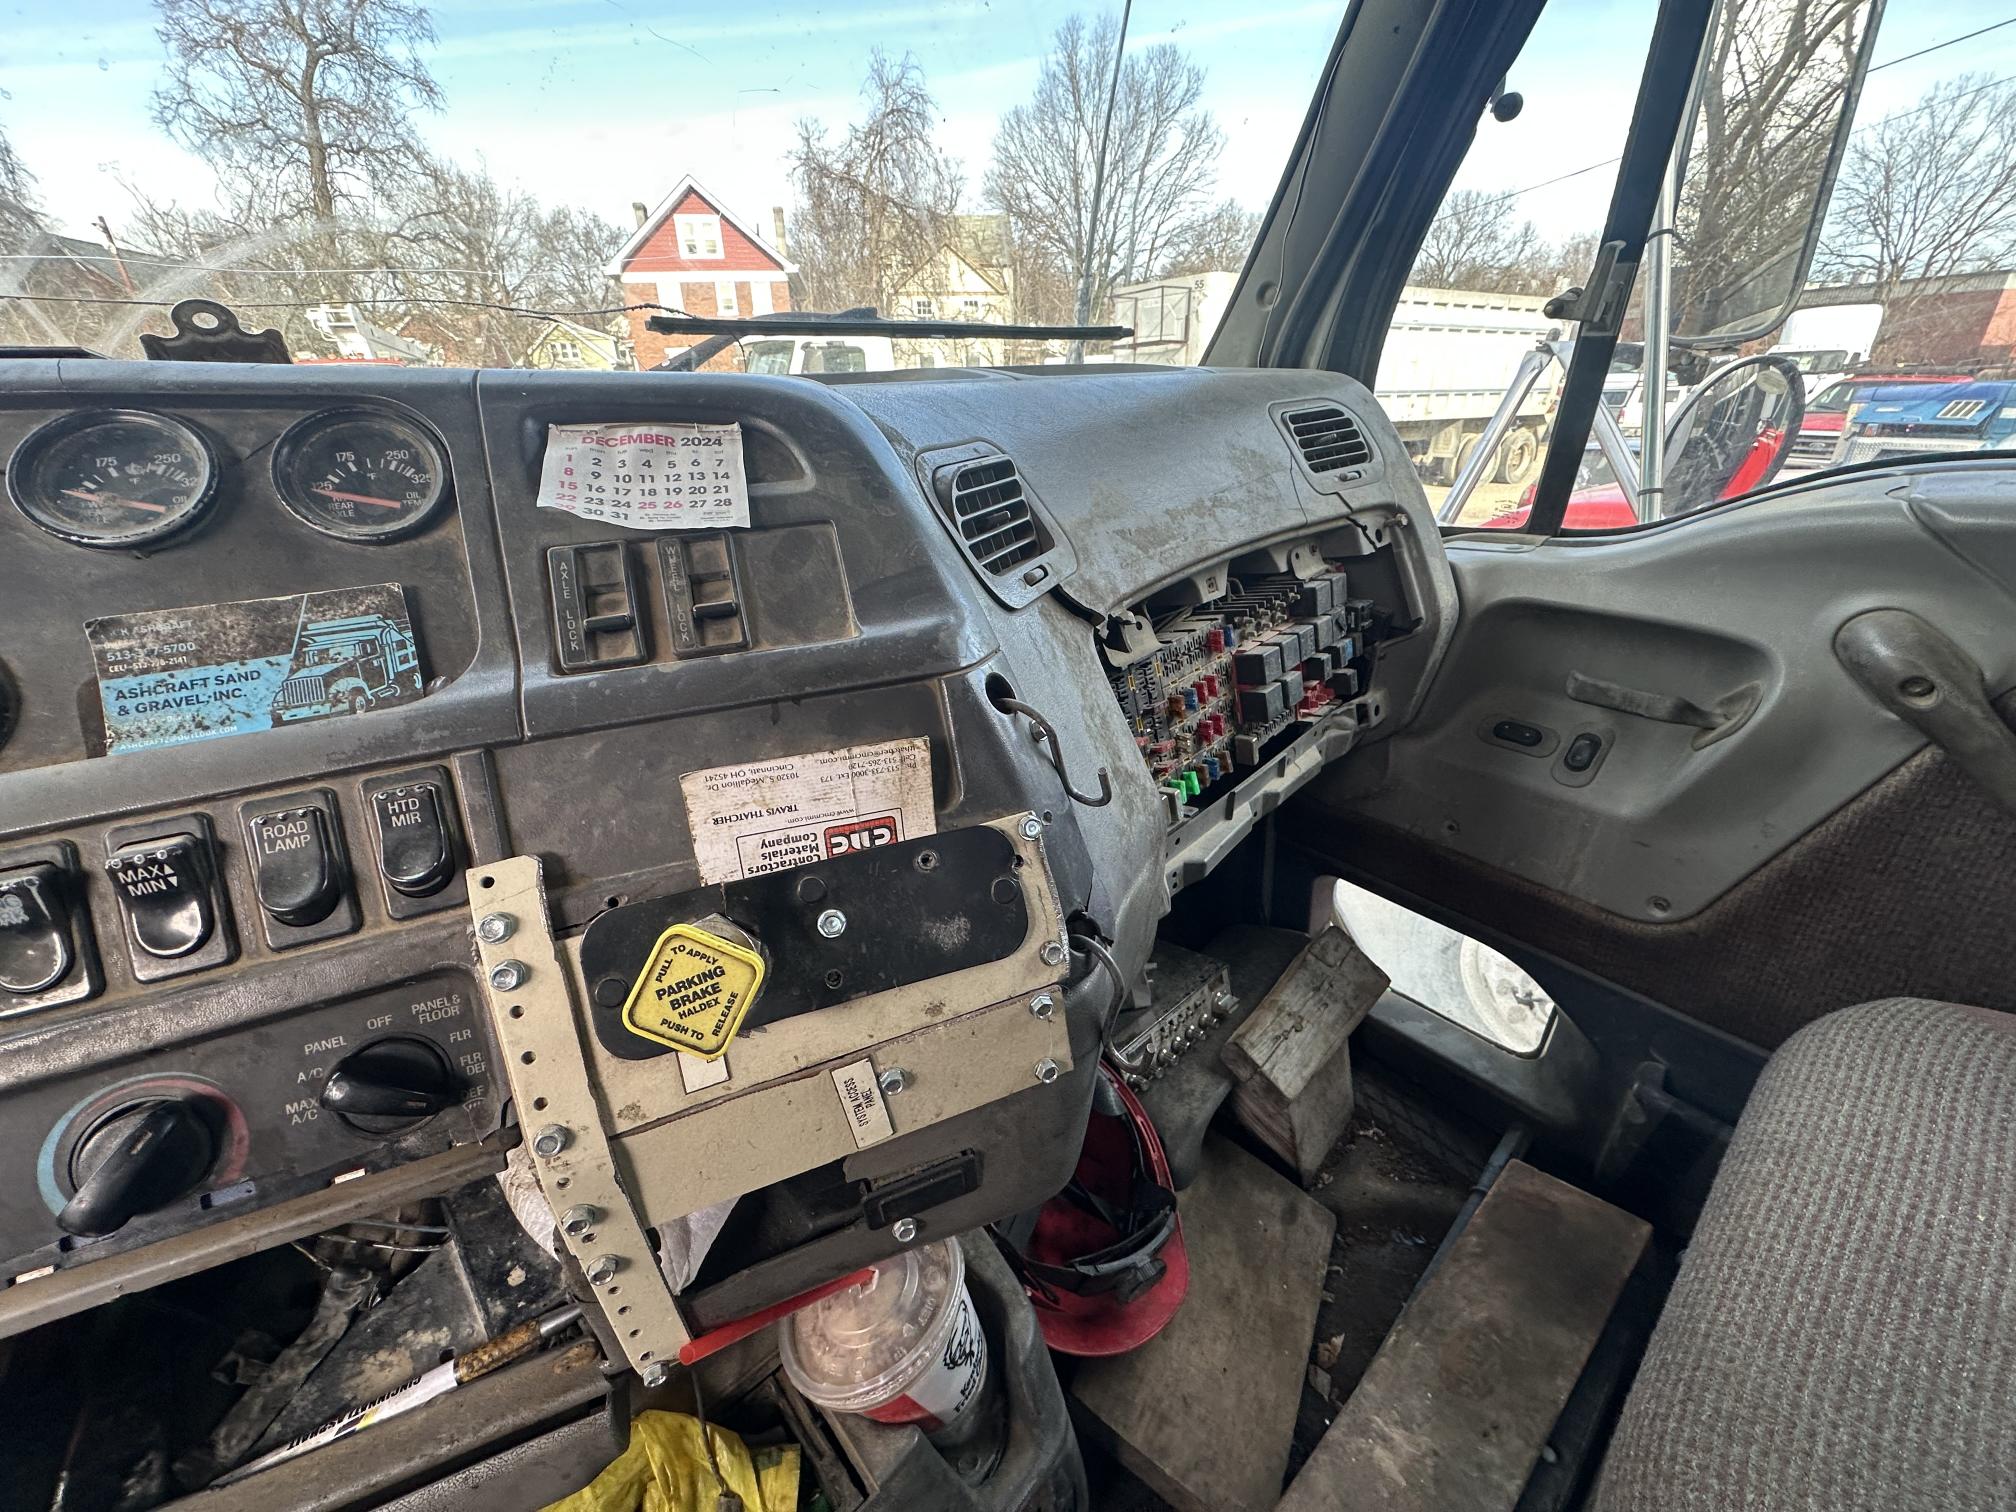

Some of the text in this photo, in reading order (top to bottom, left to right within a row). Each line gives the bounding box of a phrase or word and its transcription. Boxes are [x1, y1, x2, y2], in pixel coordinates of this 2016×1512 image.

[1194, 280, 1204, 290] 55
[582, 434, 723, 448] DECEMBER 2024
[96, 456, 118, 468] 175
[154, 453, 181, 464] 250
[336, 452, 355, 462] 175
[385, 450, 408, 460] 250
[566, 454, 572, 462] 1
[592, 458, 602, 467] 2
[618, 460, 627, 468] 3
[642, 460, 652, 468] 4
[667, 460, 677, 468] 5
[564, 467, 730, 484] 8 9 10 11 12 13 14
[558, 480, 729, 496] 15 16 17 18 19 20 21
[555, 492, 732, 510] 22 23 24 25 26 27 28
[582, 508, 604, 516] 30
[610, 512, 629, 520] 31
[560, 562, 571, 599] AXLE
[566, 610, 579, 651] LOCK
[677, 604, 689, 642] LOCK
[115, 670, 262, 701] ASHCRAFT SAND
[118, 705, 130, 716] &
[213, 688, 247, 701] INC.
[705, 763, 794, 783] Cincinnati, OH 45241
[777, 772, 800, 781] 10320
[705, 784, 720, 792] Dr.
[722, 777, 765, 789] Medallion
[387, 798, 420, 814] HTD
[712, 804, 799, 826] TRAVIS THATCHER
[391, 811, 422, 828] MIR
[262, 820, 308, 840] ROAD
[264, 835, 311, 854] LAMP
[760, 833, 818, 850] Company
[761, 842, 820, 861] Materials
[748, 854, 821, 875] Contractors
[118, 864, 164, 884] MAX
[128, 878, 167, 897] MIN
[656, 944, 719, 983] PULL TO APPLY
[655, 966, 726, 1000] PARKING
[412, 994, 461, 1015] PANEL &
[669, 982, 722, 1011] BRAKE
[419, 1006, 461, 1024] FLOOR
[660, 991, 738, 1040] PUSH TO RELEASE
[678, 997, 721, 1020] HALDEX
[366, 1015, 393, 1030] OFF
[304, 1036, 348, 1055] PANEL
[450, 1029, 472, 1044] FLR
[460, 1052, 482, 1067] FLR
[297, 1067, 324, 1084] A/C
[466, 1062, 487, 1076] DEF
[285, 1098, 320, 1115] MAX
[844, 1077, 871, 1127] SYSTEM ACCESS
[860, 1088, 876, 1109] PANEL
[291, 1110, 318, 1126] A/C
